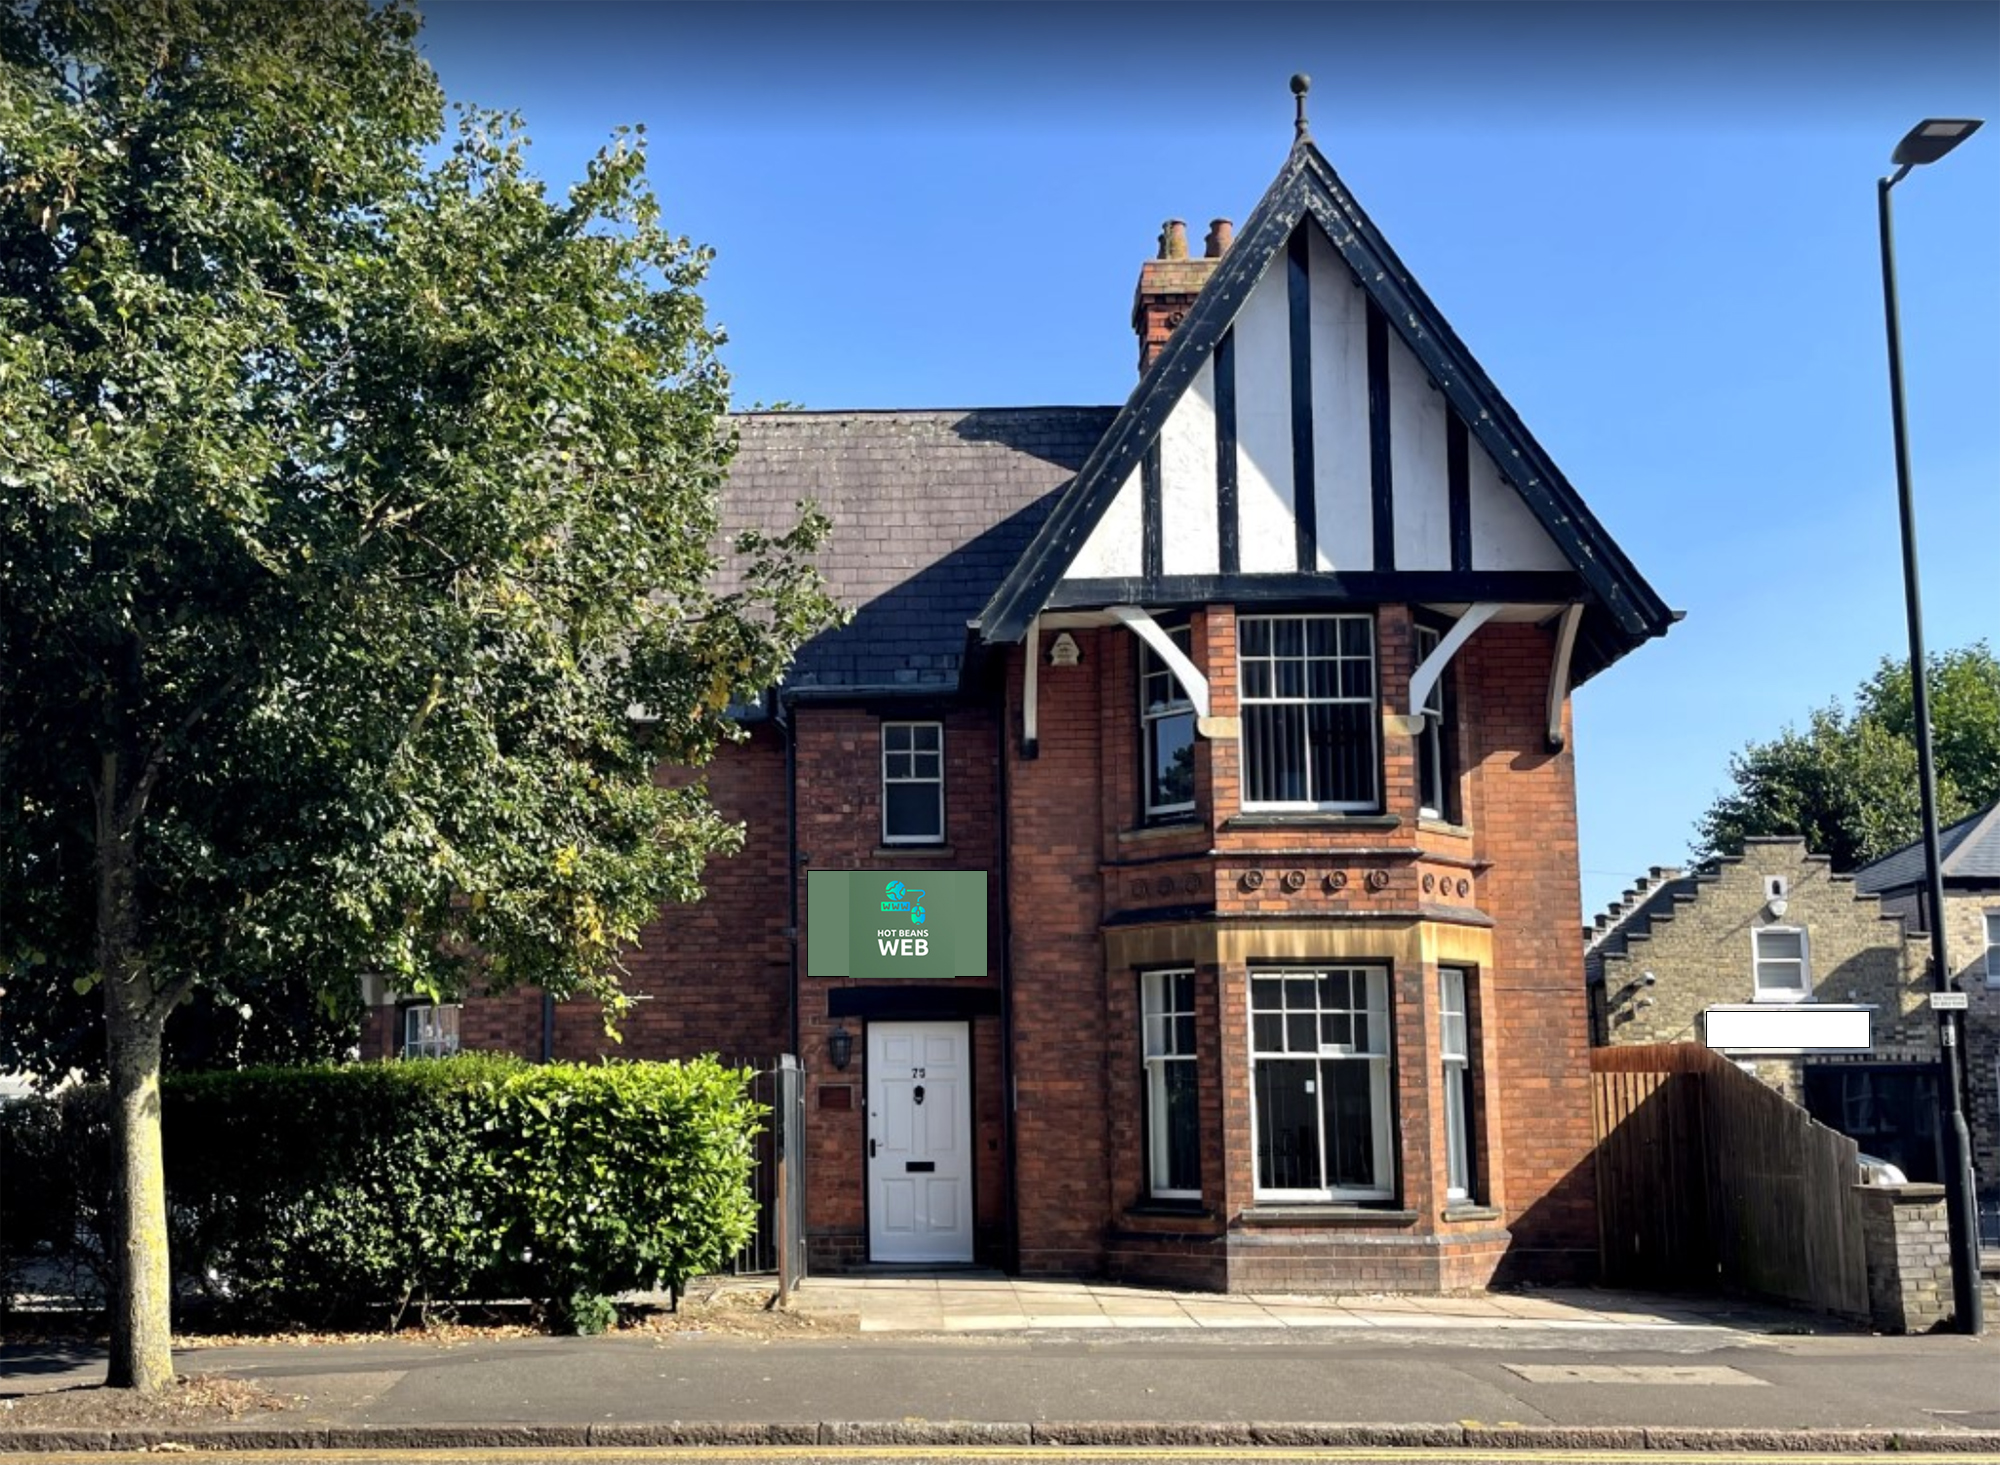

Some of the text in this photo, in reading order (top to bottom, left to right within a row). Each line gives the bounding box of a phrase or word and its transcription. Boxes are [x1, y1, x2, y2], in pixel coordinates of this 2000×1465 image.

[882, 902, 909, 910] WWW
[877, 929, 929, 937] HOT BEANS
[877, 938, 929, 956] WEB
[911, 1067, 926, 1079] 75
